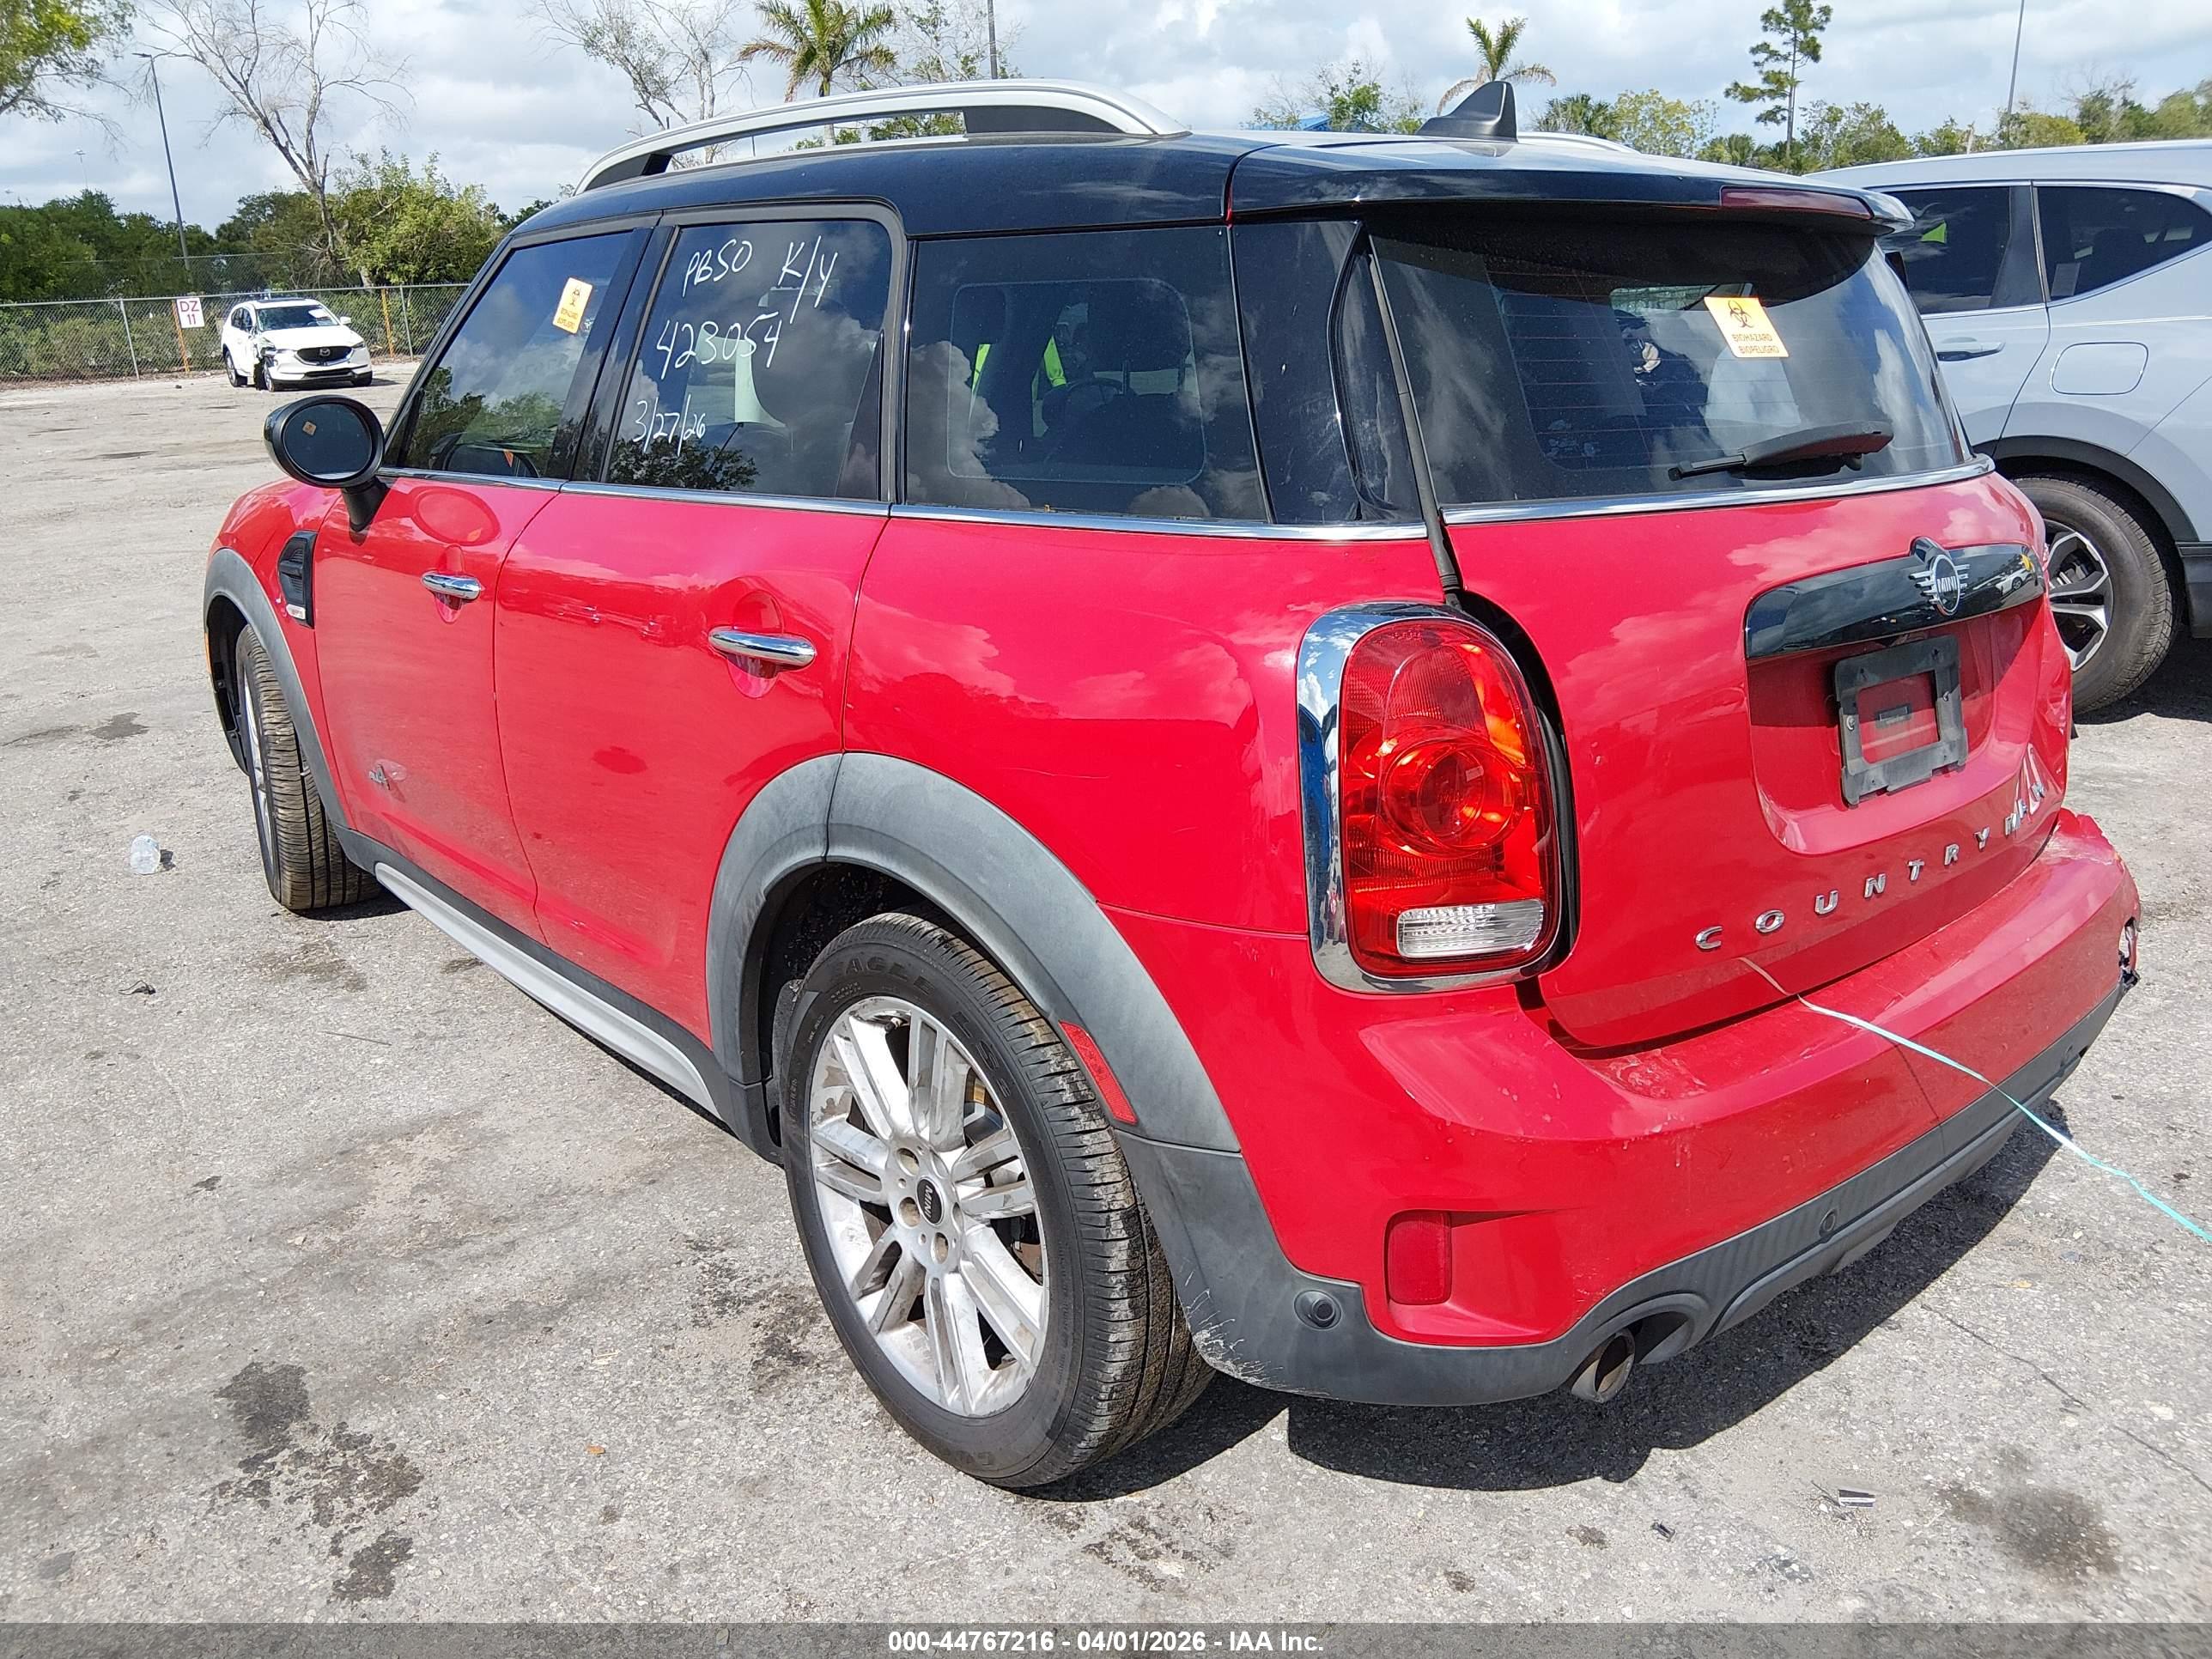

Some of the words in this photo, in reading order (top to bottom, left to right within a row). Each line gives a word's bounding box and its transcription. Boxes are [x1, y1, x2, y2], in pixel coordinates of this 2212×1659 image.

[179, 301, 199, 312] DZ
[187, 314, 196, 325] 11
[633, 394, 706, 457] 3/27/26
[1937, 575, 1957, 592] MINI
[924, 1185, 933, 1218] MINI
